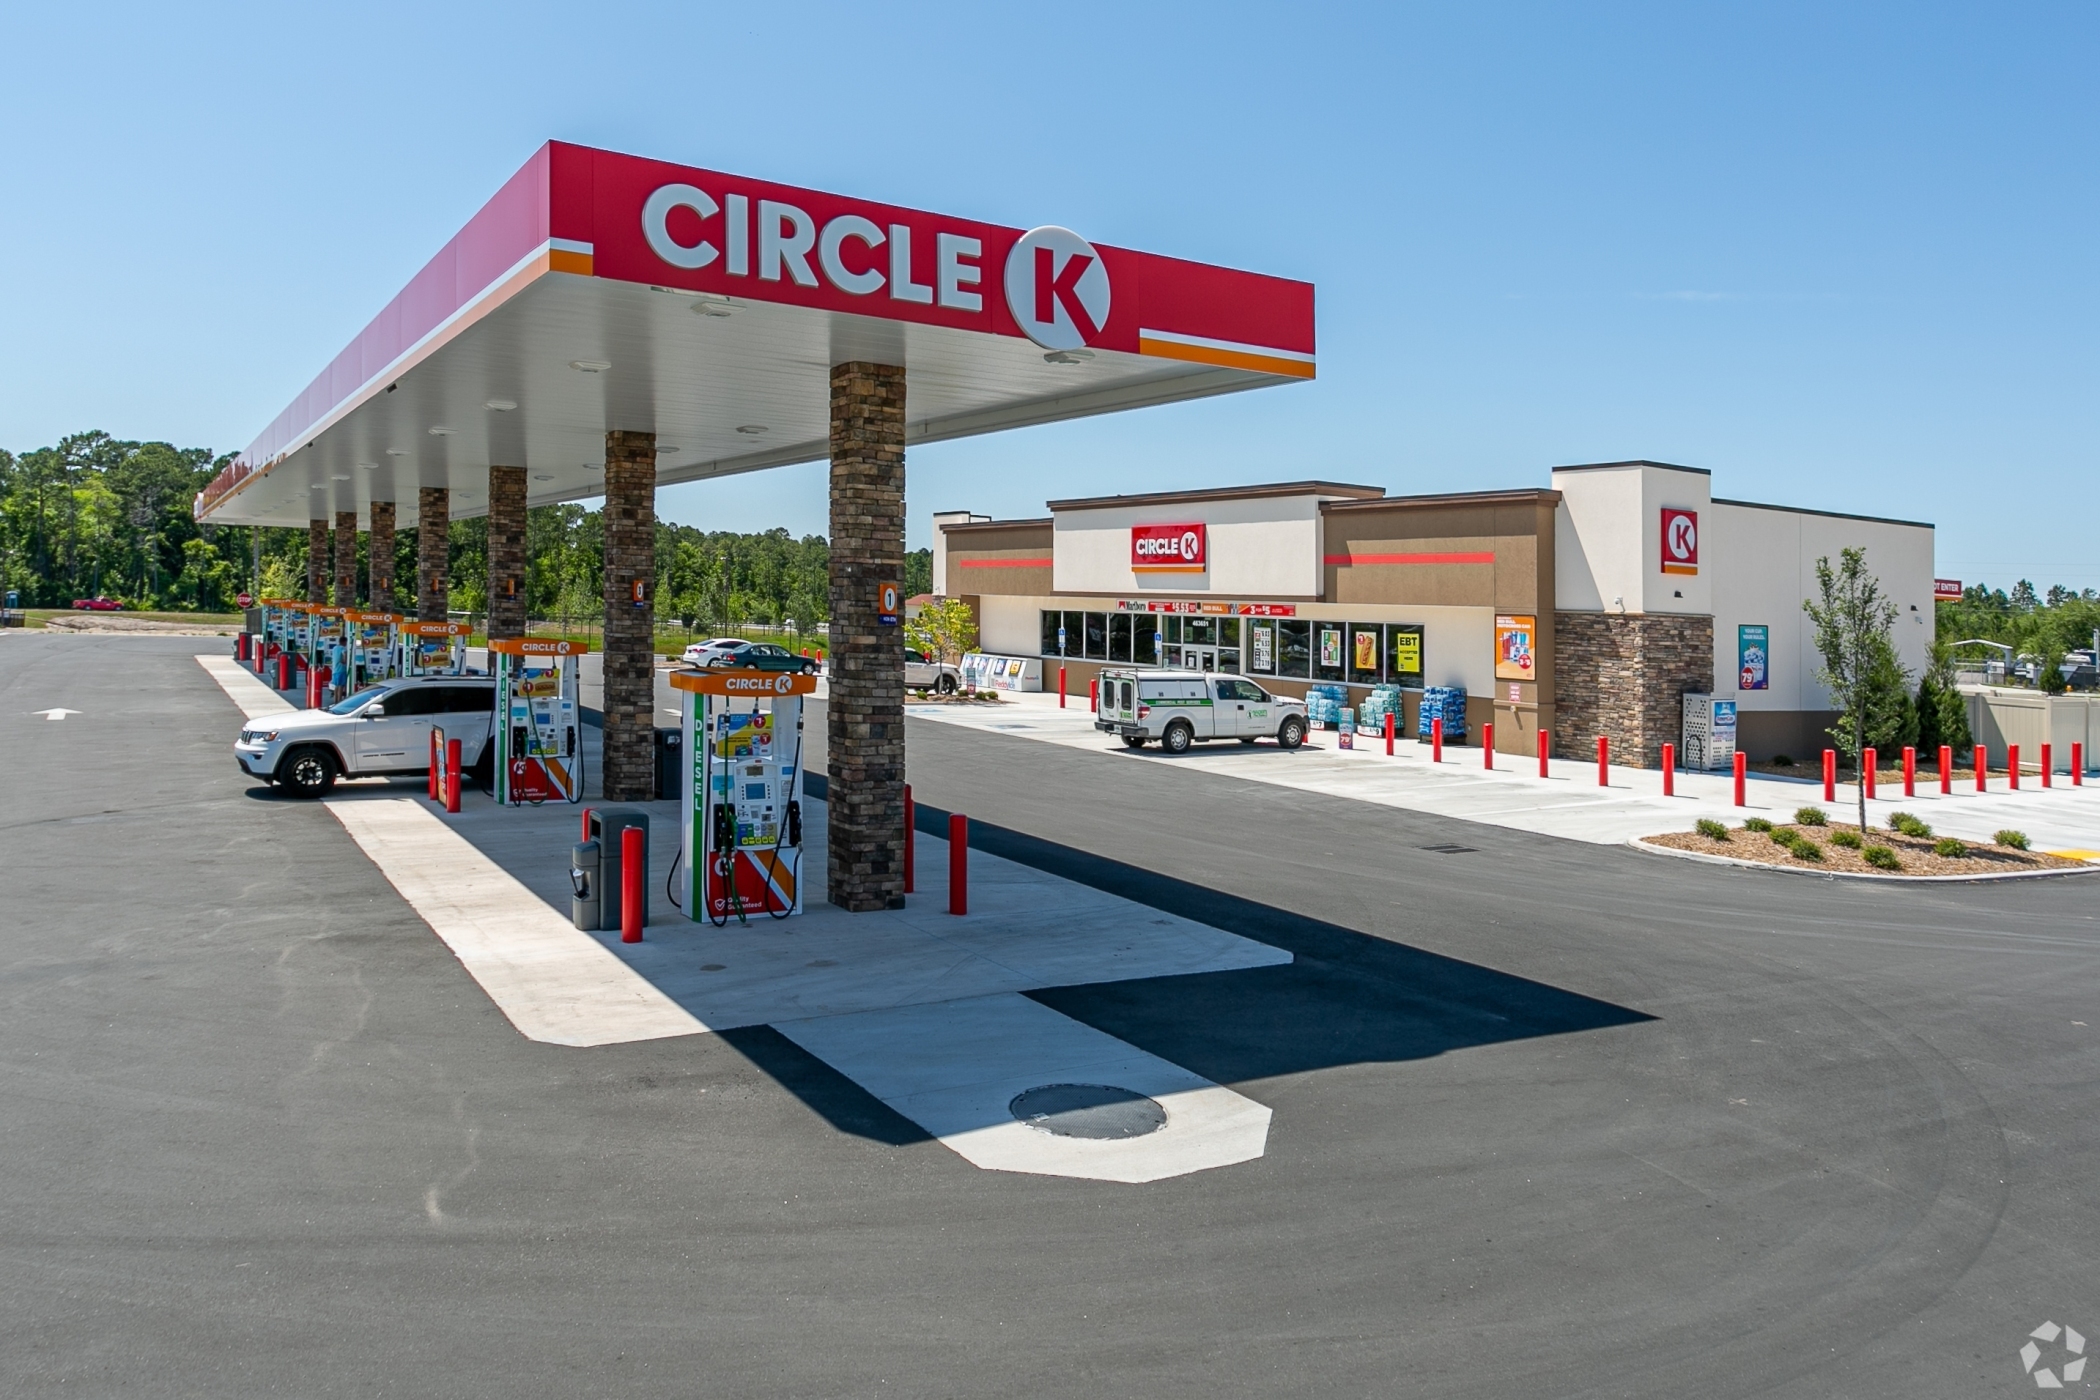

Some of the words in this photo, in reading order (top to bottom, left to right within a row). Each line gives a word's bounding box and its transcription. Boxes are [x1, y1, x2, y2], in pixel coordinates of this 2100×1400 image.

[642, 183, 983, 312] CIRCLE
[1034, 246, 1101, 347] K
[1136, 538, 1178, 555] CIRCLE
[1941, 583, 1959, 592] ENTER
[1126, 601, 1146, 611] Marlboro
[1400, 637, 1417, 646] EBT
[522, 643, 556, 652] CIRCLE
[726, 678, 773, 690] CIRCLE
[695, 719, 703, 811] DIESEL
